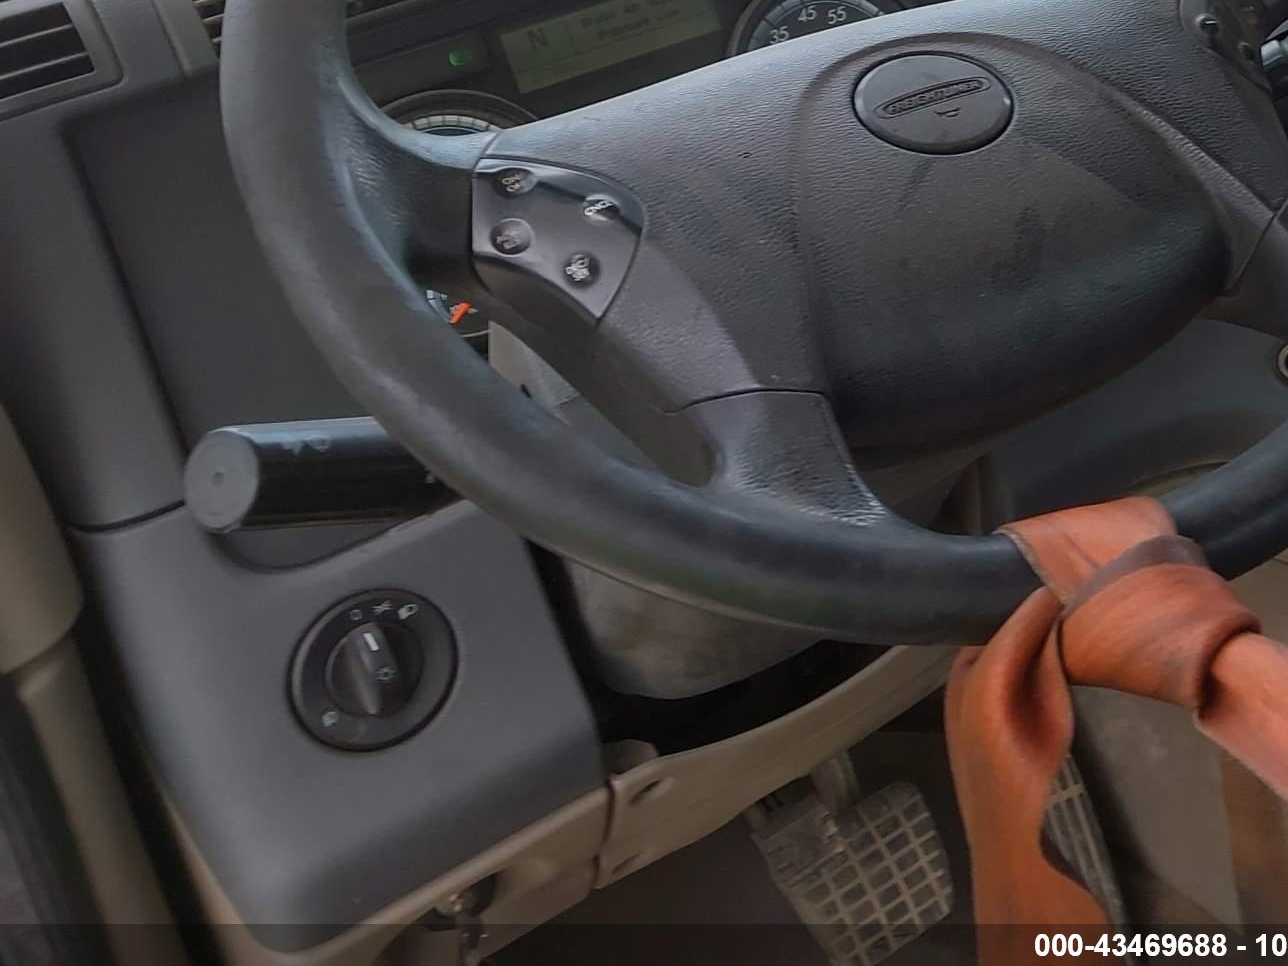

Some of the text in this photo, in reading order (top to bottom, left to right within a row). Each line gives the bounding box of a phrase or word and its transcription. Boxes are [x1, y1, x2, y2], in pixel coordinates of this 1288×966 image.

[797, 5, 818, 23] 45
[827, 6, 848, 25] 55
[527, 27, 549, 50] N
[769, 25, 790, 45] 35
